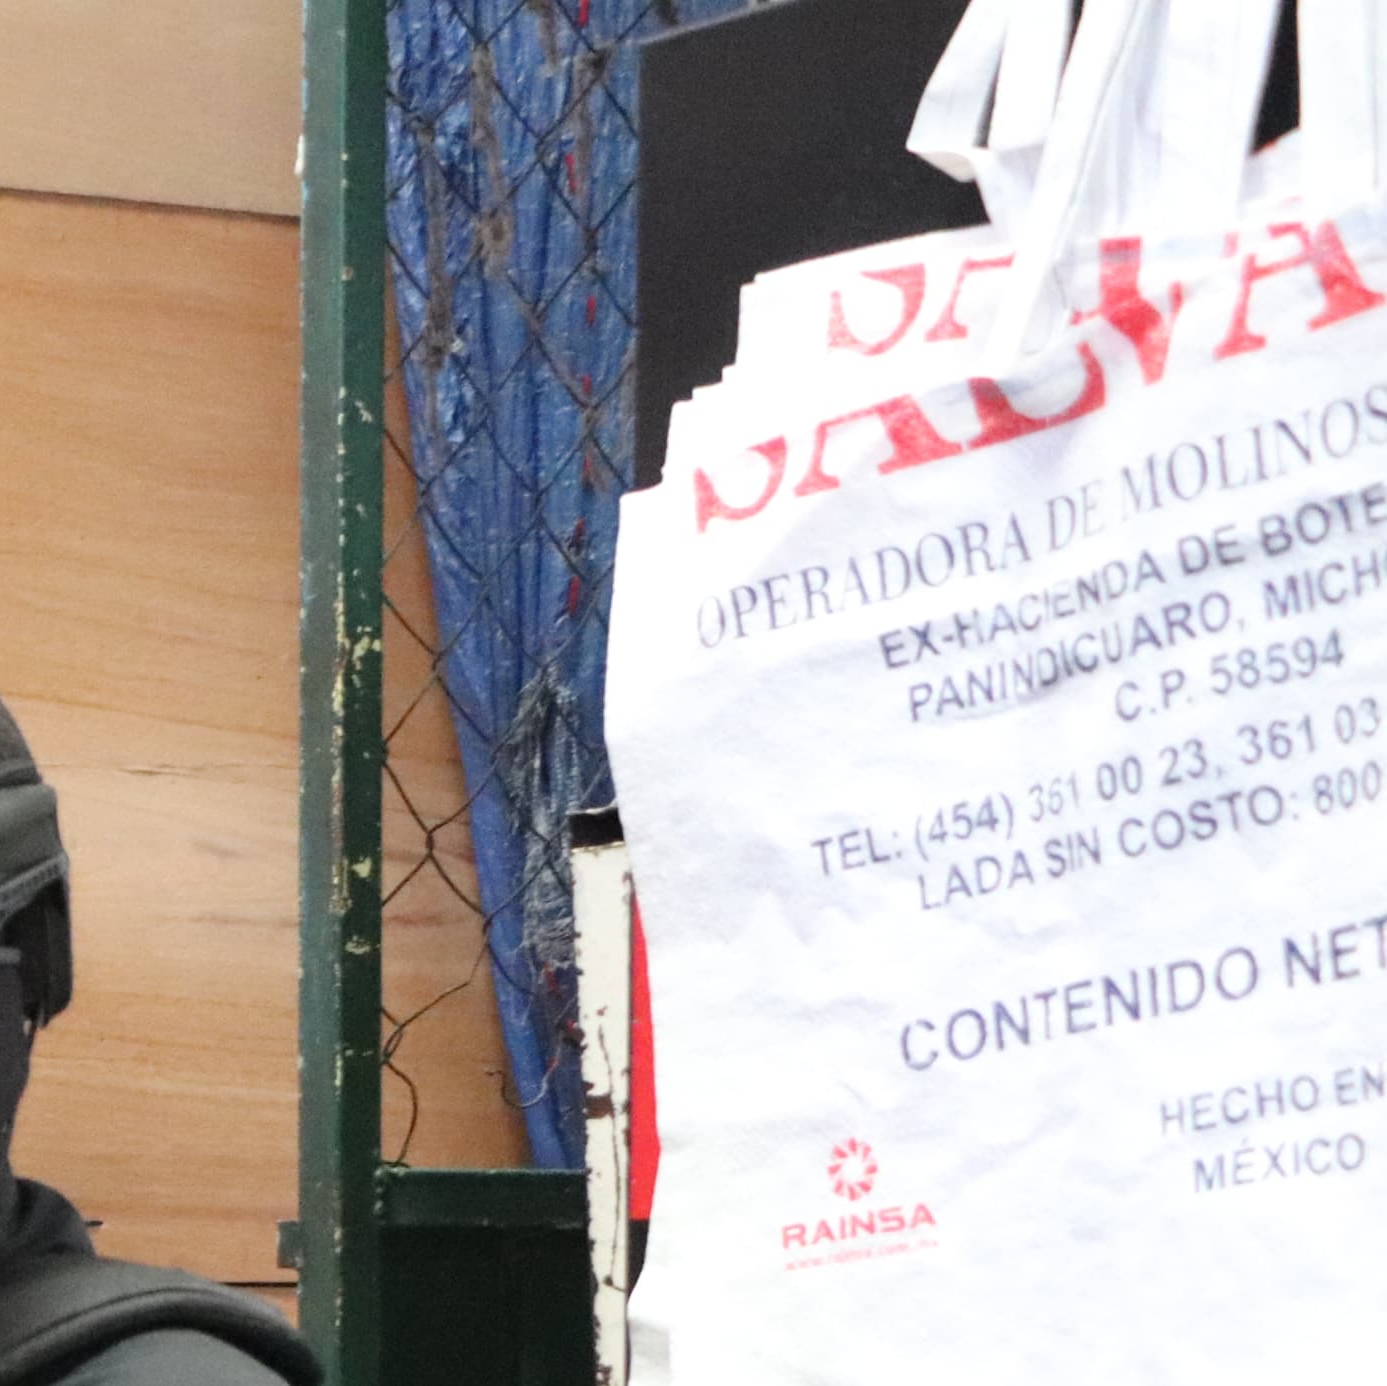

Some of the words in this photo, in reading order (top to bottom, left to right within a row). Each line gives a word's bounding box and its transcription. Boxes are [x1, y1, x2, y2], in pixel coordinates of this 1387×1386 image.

[695, 510, 1032, 650] OPERADORA
[1047, 481, 1109, 552] DE
[1117, 384, 1387, 522] MOLINOS
[878, 549, 1167, 671] EX-HACIENDA
[1177, 522, 1246, 577] DE
[1114, 668, 1195, 722] C.P.
[1209, 628, 1345, 695] 58594
[811, 827, 904, 877] TEL:
[915, 791, 1017, 864] (454)
[1028, 772, 1082, 824] 361
[1096, 755, 1143, 801] 00
[1237, 714, 1316, 765] 361
[1334, 696, 1381, 745] 03
[917, 850, 1036, 911] LADA
[1044, 825, 1102, 877] SIN
[1117, 785, 1300, 858] COSTO:
[1312, 760, 1383, 815] 800
[899, 945, 1261, 1073] CONTENIDO
[1159, 1074, 1320, 1137] HECHO
[1332, 1062, 1385, 1107] EN
[781, 1202, 938, 1250] RAINSA
[1193, 1136, 1367, 1193] MÉXICO
